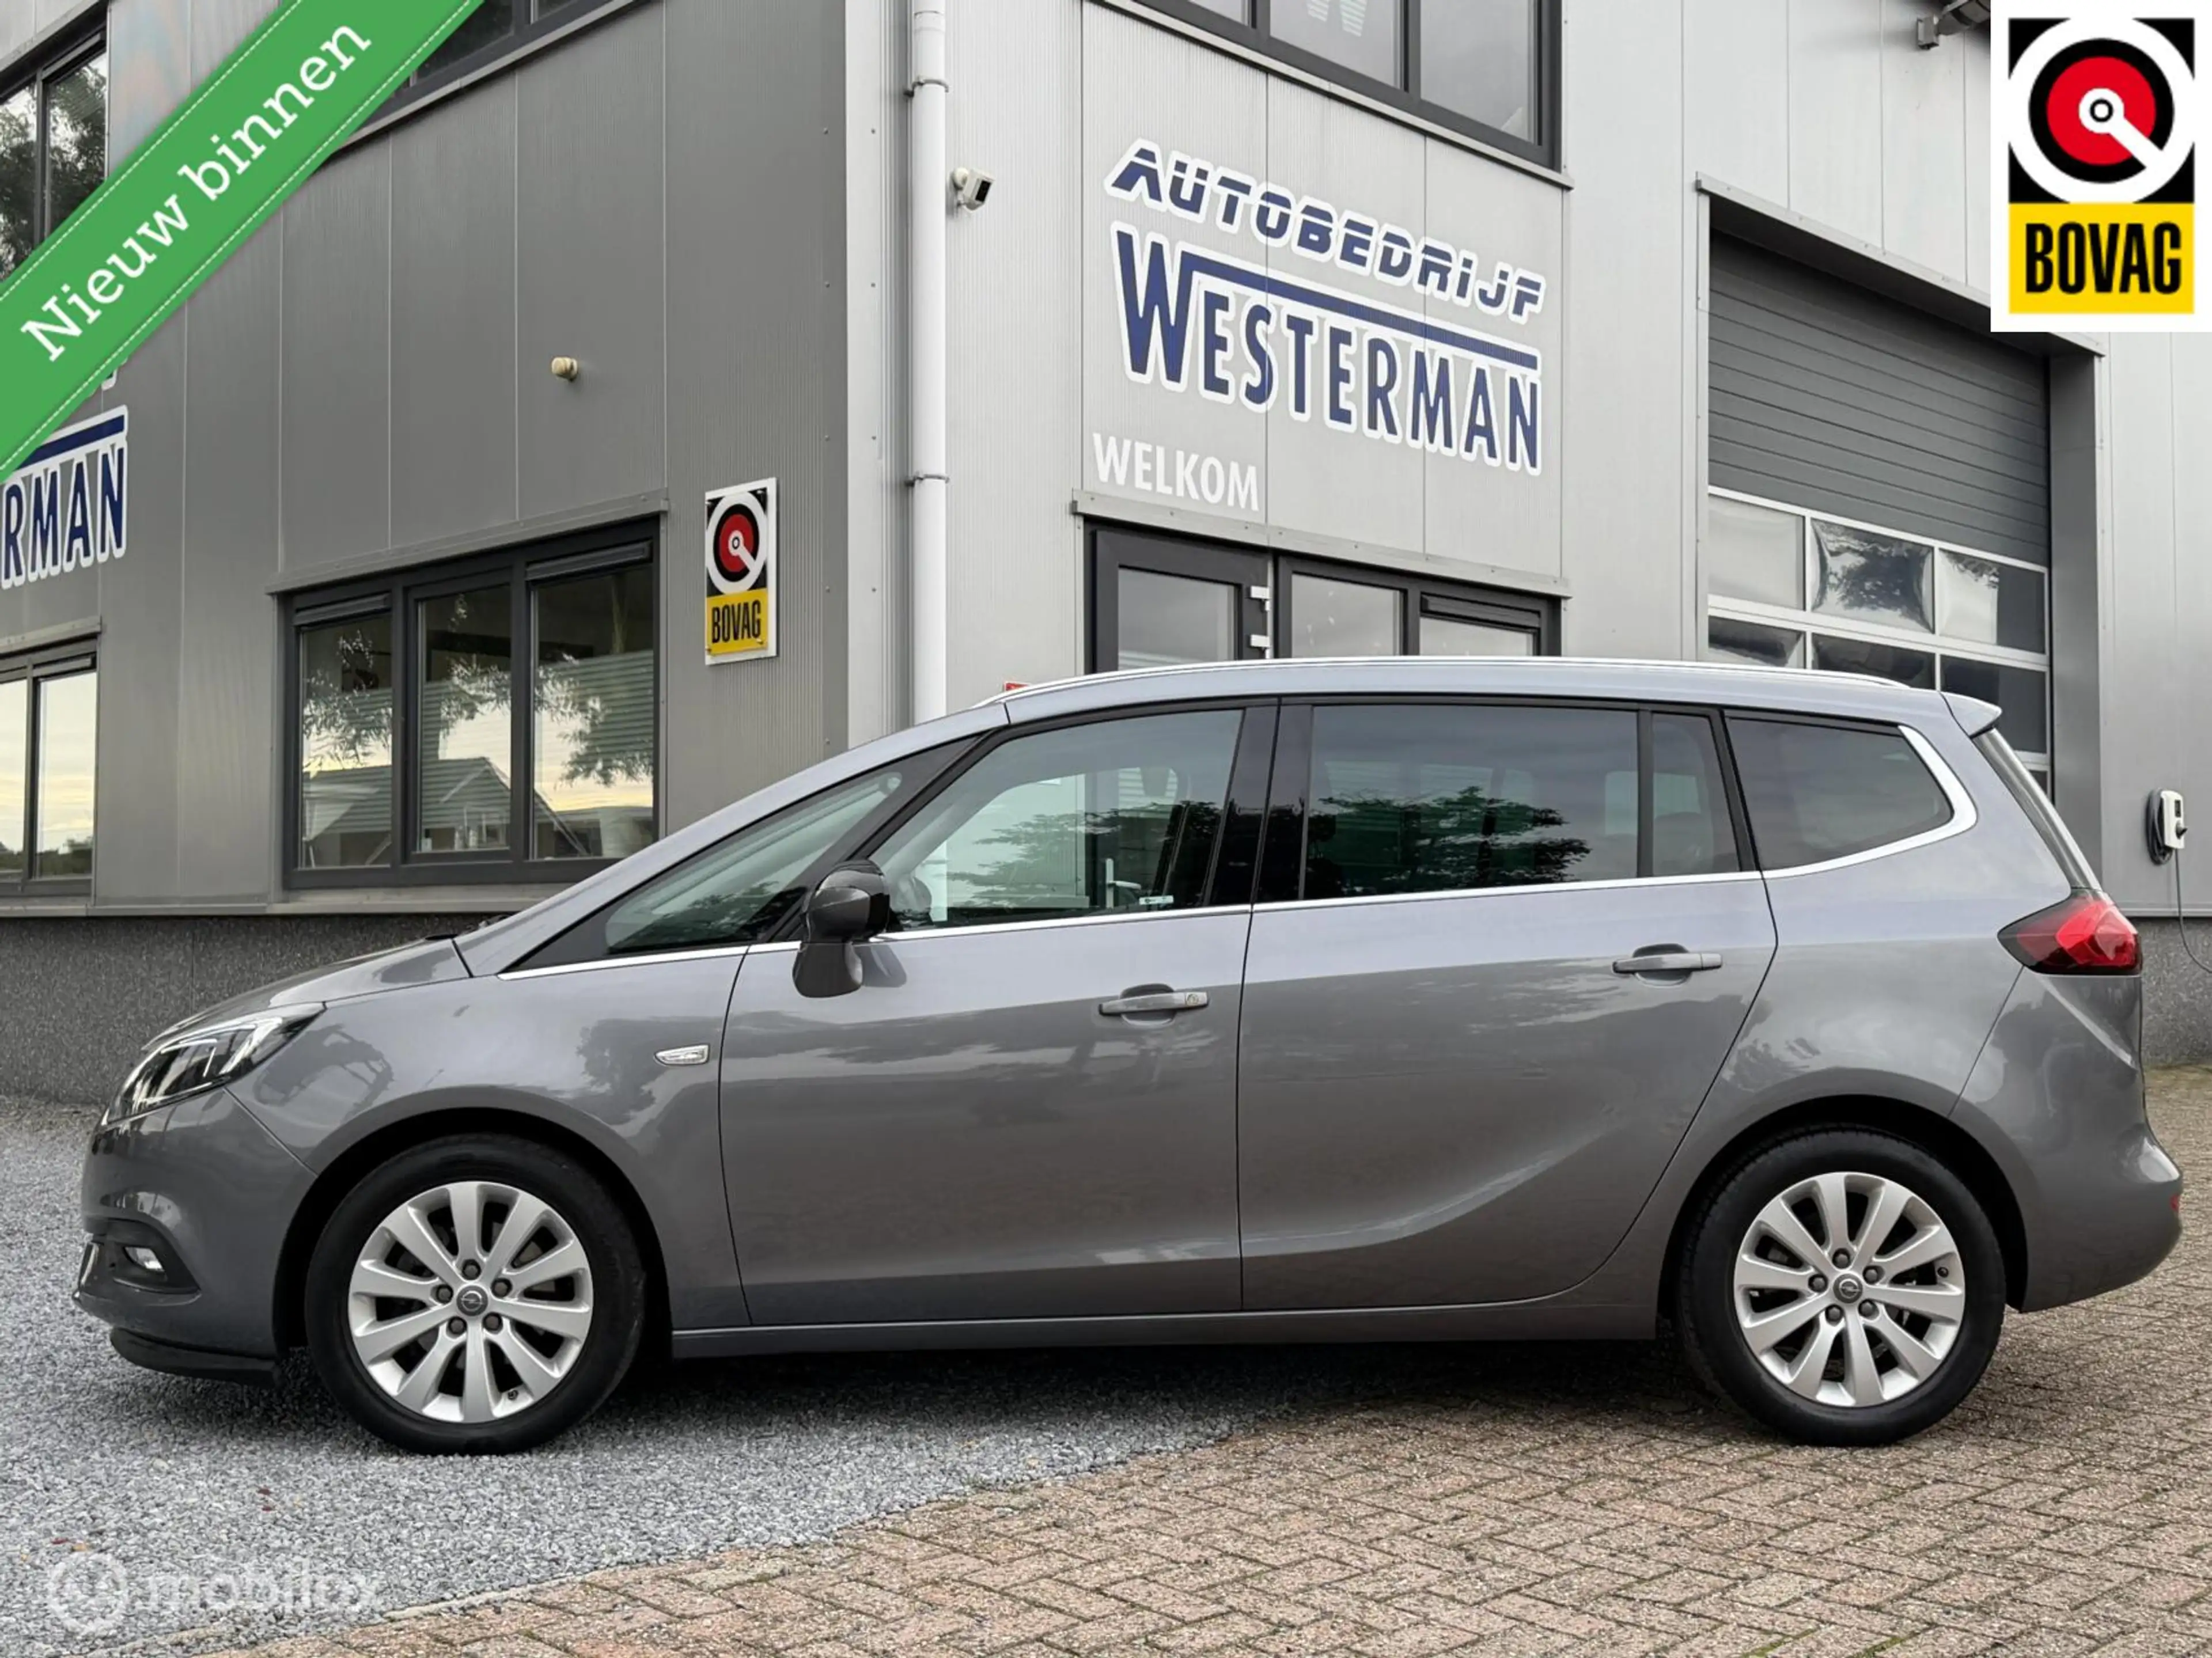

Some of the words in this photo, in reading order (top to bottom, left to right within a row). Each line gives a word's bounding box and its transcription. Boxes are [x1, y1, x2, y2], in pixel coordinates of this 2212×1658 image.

[1109, 145, 1544, 320] AUTOBEDRIJF
[1115, 229, 1539, 470] WESTERMAN
[1092, 432, 1259, 512] WELKOM
[711, 600, 761, 644] BOVAG
